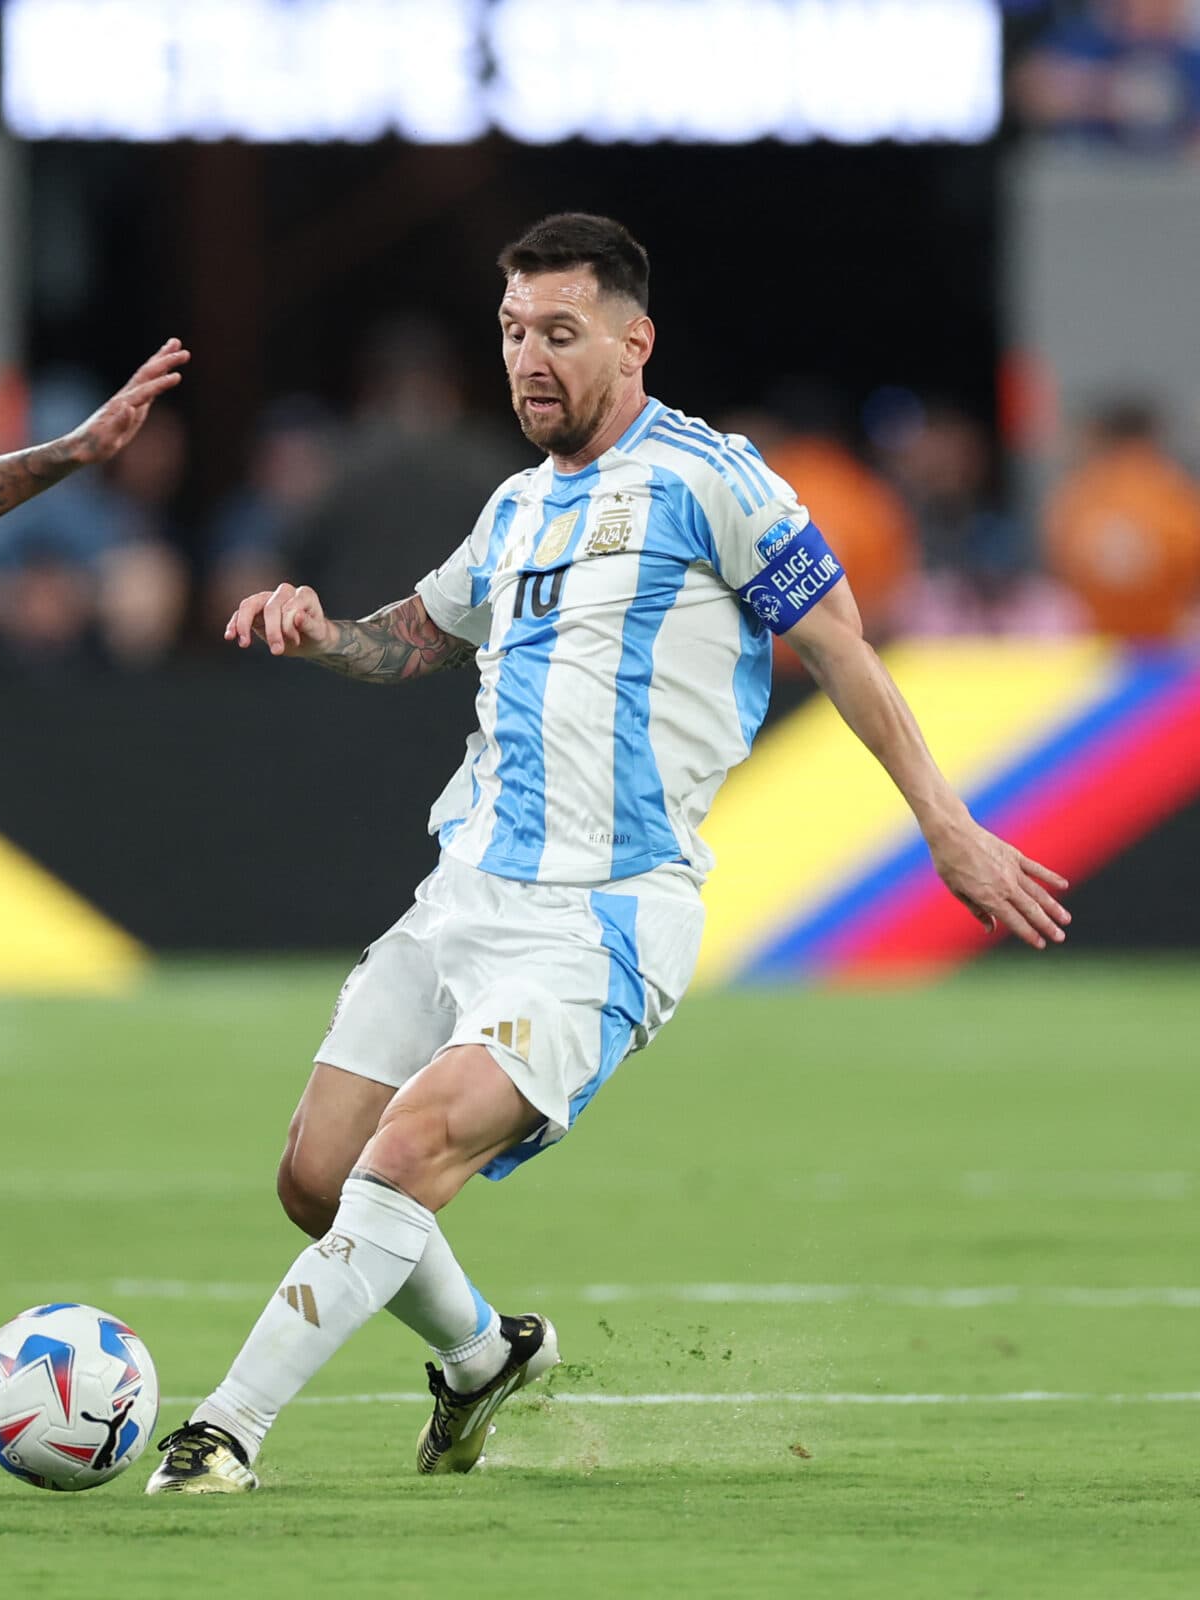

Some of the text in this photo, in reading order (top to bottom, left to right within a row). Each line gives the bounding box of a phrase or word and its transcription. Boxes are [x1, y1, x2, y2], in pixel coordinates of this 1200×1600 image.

[765, 528, 798, 557] VIBRA
[770, 546, 814, 593] ELIGE
[785, 553, 840, 610] INCLUIR
[513, 570, 566, 618] 10
